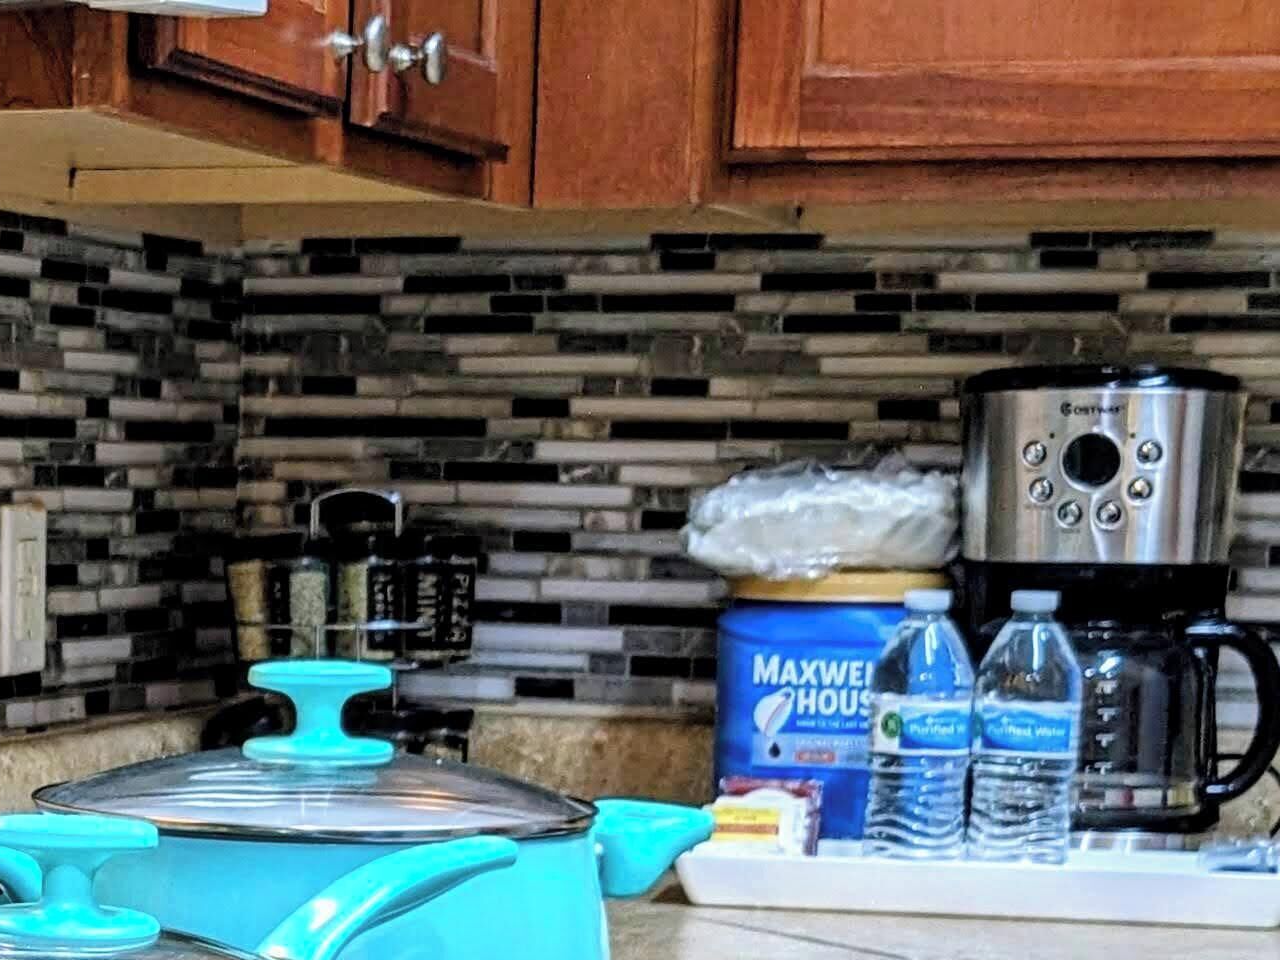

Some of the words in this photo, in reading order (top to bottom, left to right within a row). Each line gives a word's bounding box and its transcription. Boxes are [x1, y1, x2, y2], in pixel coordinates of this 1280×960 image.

[416, 572, 438, 643] MINT
[752, 652, 872, 687] MAXWEL
[796, 686, 872, 718] HOUS
[1034, 722, 1067, 738] Water
